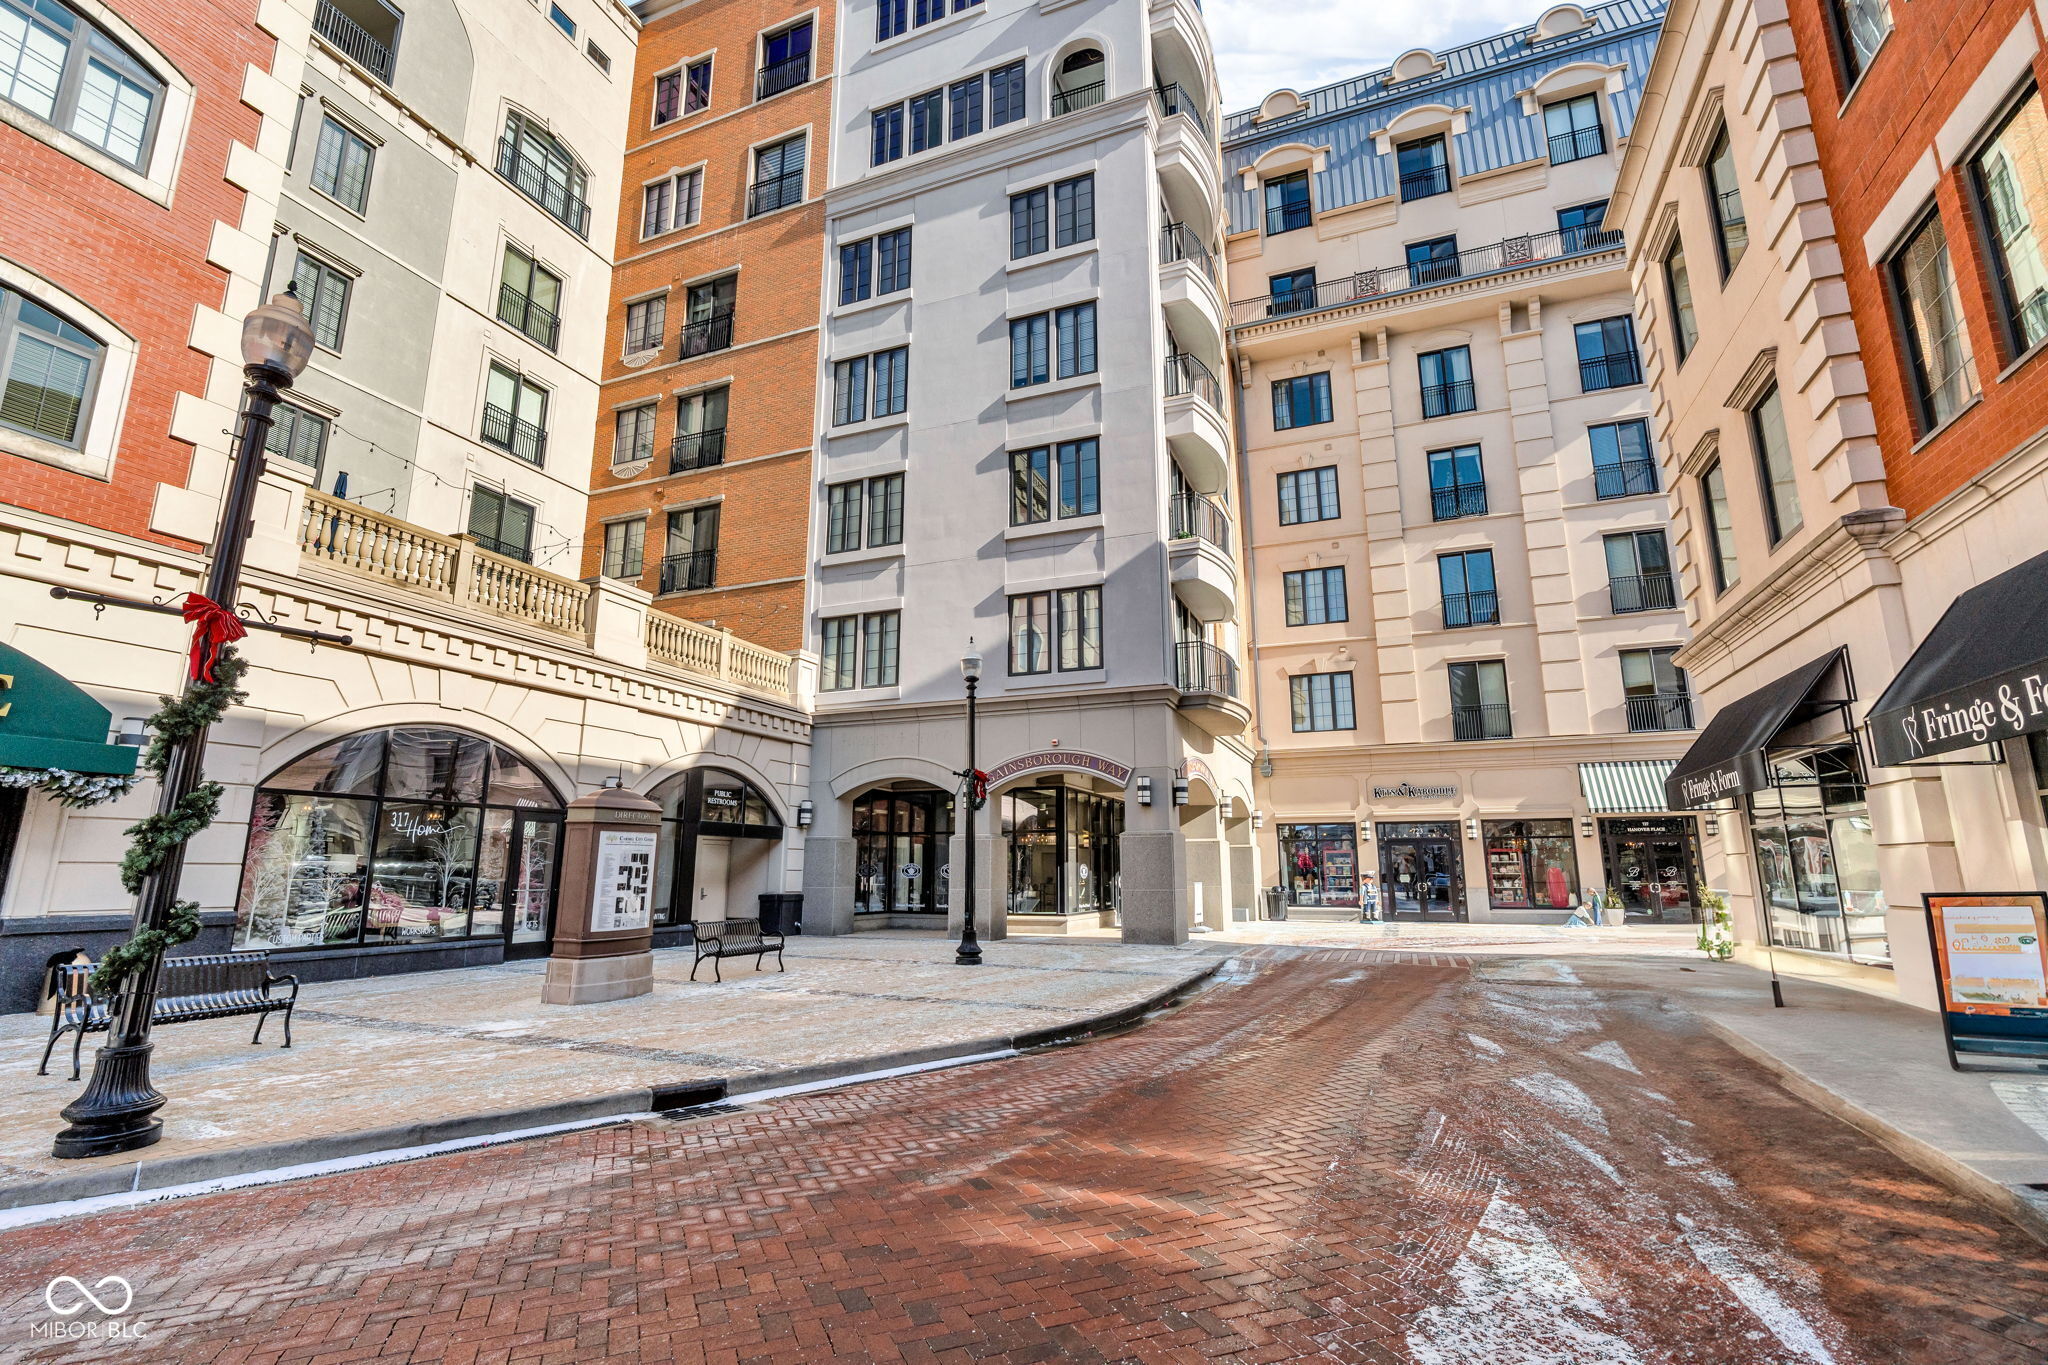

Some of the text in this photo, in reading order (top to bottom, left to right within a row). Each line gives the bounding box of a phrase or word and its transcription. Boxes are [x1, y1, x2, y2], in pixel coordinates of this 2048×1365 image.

[1921, 698, 1997, 742] Fringe
[1998, 684, 2025, 731] &
[986, 753, 1126, 783] GAINSBOROUGH WAY
[714, 789, 733, 798] PUBLIC
[1687, 769, 1741, 802] Fringe & Form
[707, 797, 738, 806] RESTROOMS
[390, 811, 466, 844] 317 Home
[401, 926, 436, 936] WORKSHOPS
